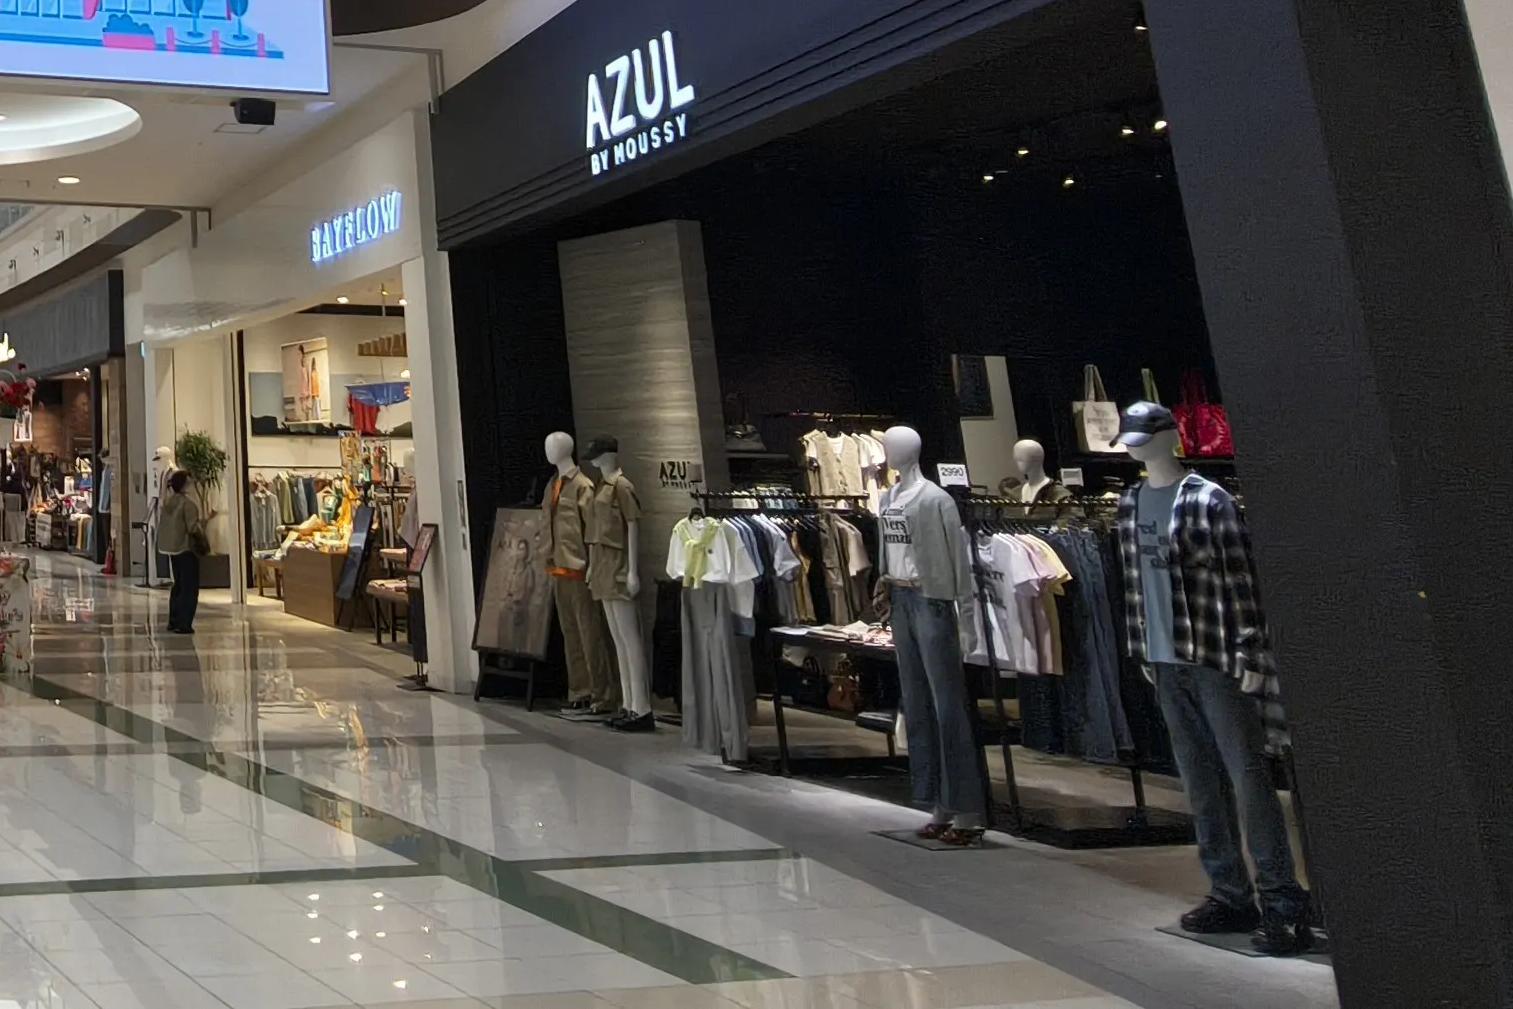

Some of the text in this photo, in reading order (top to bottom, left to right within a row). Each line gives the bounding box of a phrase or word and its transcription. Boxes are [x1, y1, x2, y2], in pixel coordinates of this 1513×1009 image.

[586, 30, 695, 149] AZUL
[590, 113, 687, 175] BY MOUSSY
[311, 191, 402, 262] BAYFLOW
[659, 461, 691, 481] AZU
